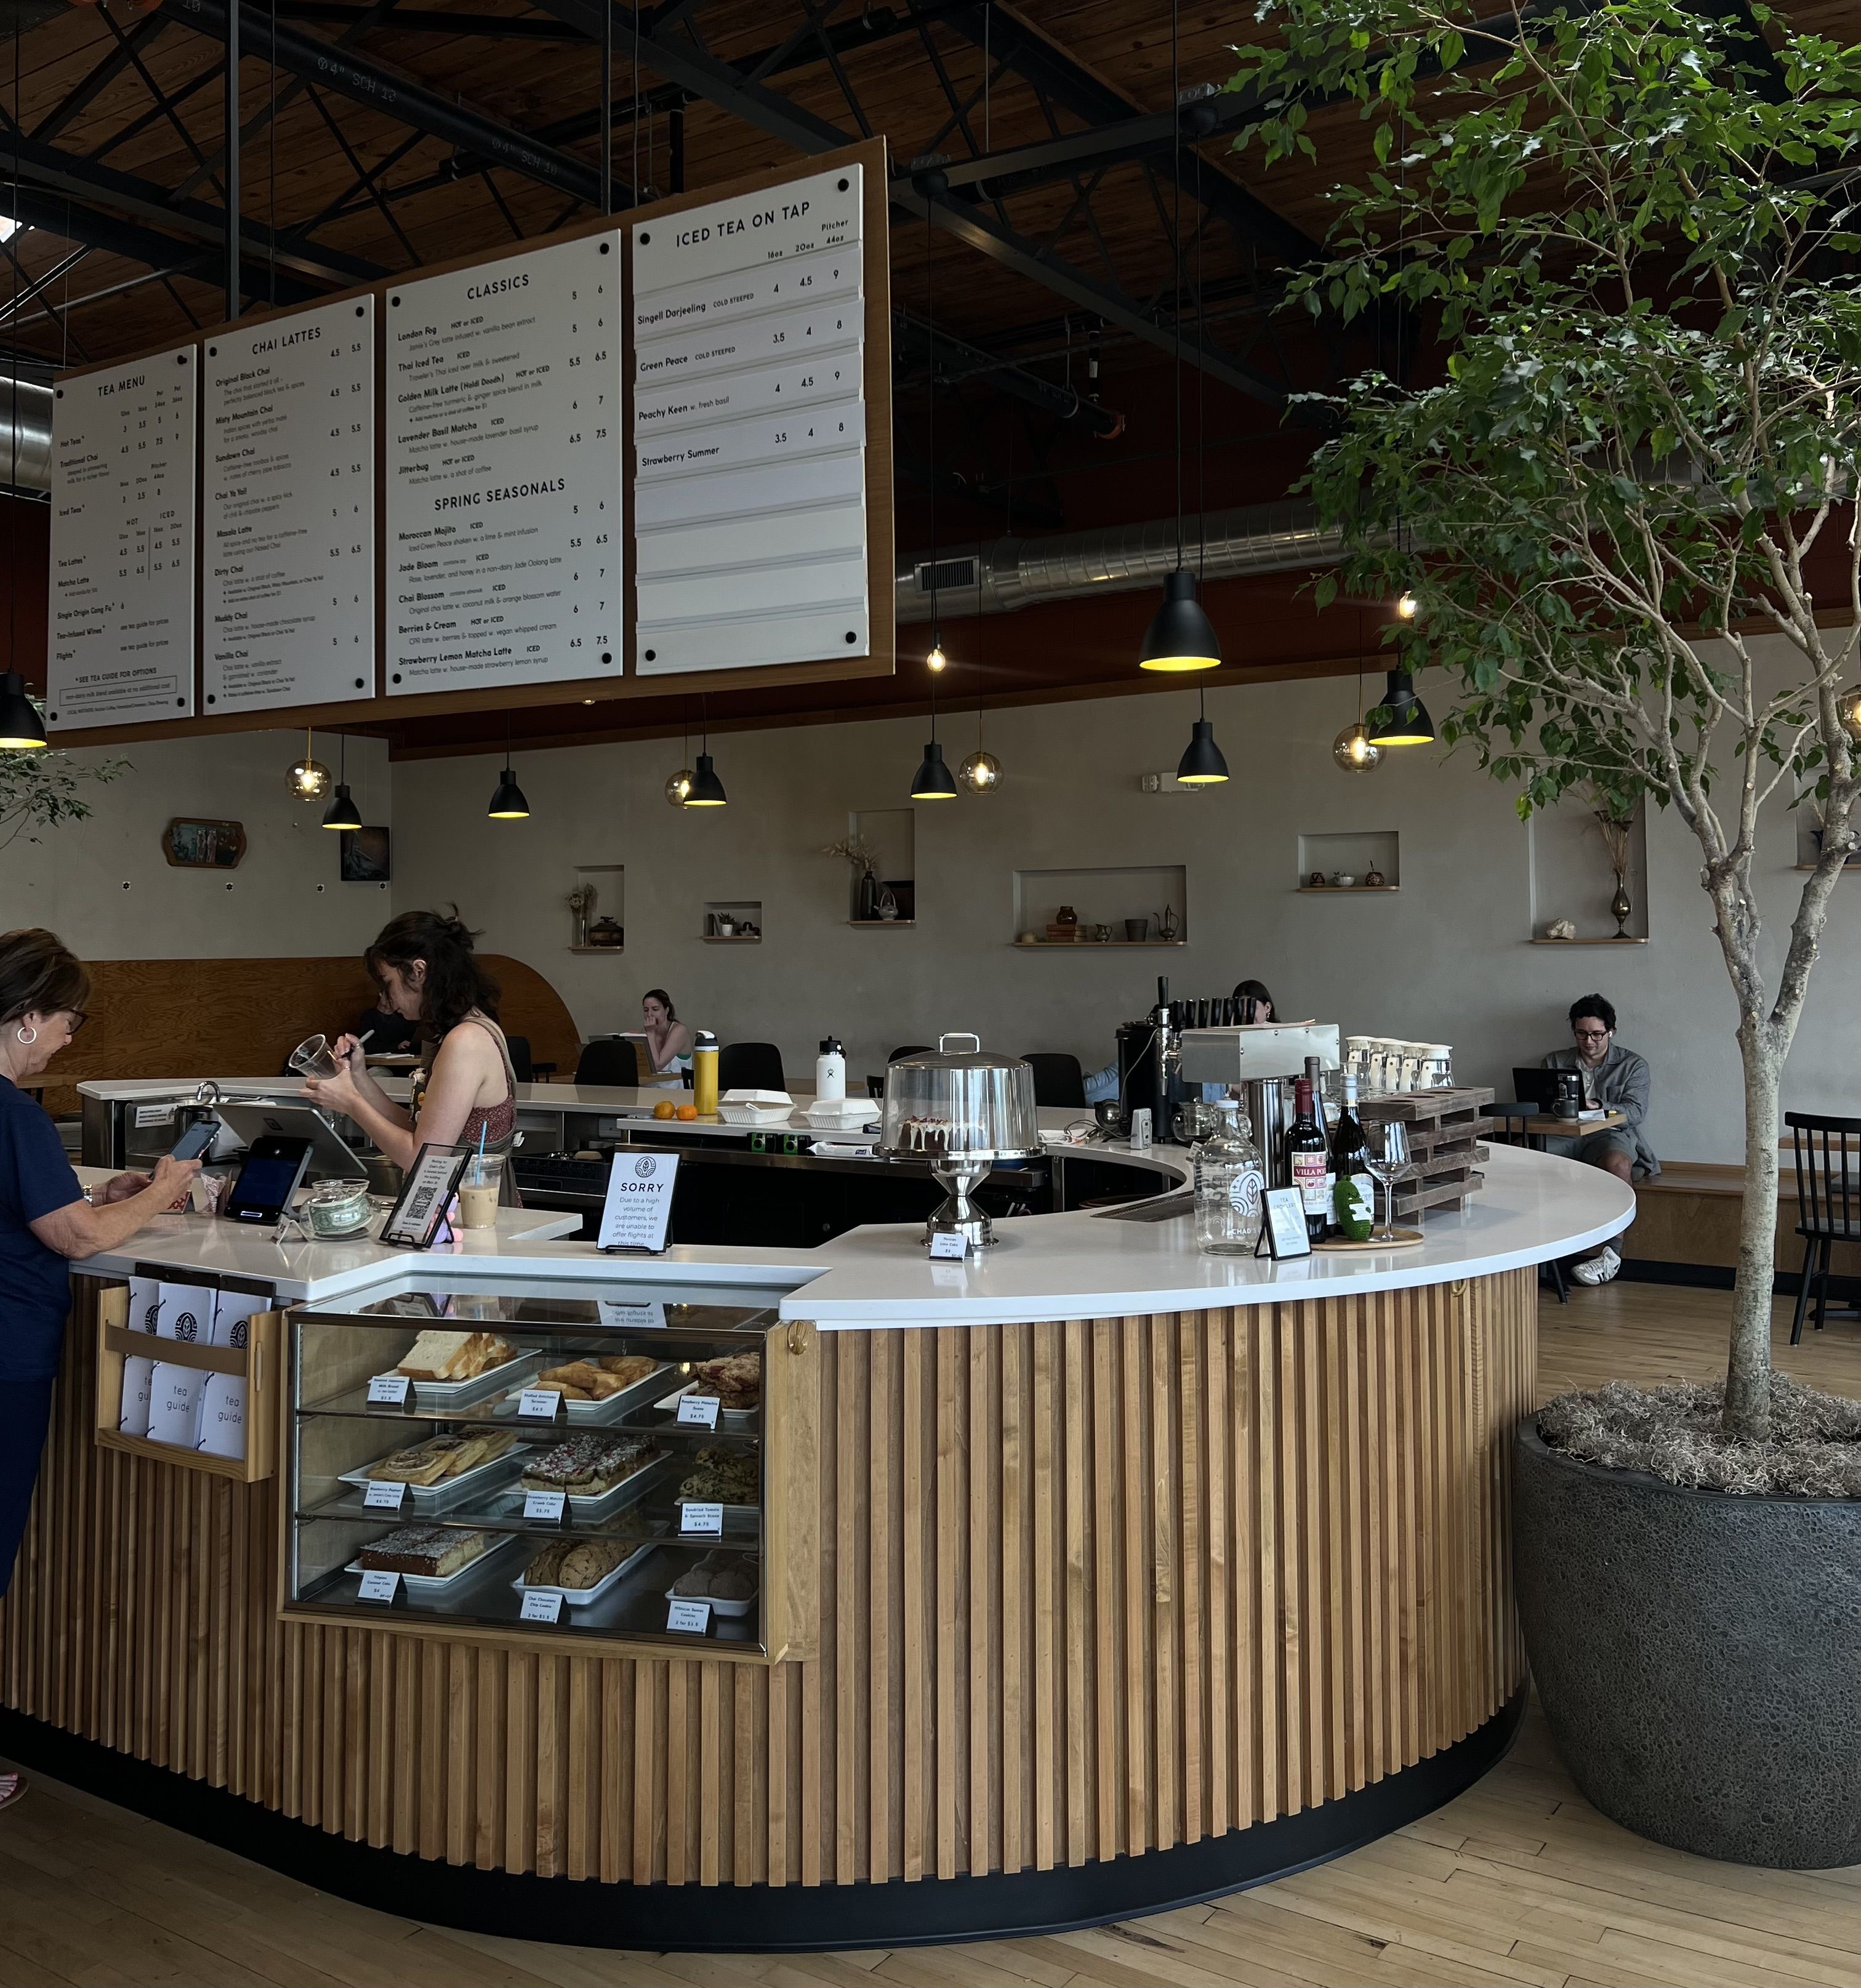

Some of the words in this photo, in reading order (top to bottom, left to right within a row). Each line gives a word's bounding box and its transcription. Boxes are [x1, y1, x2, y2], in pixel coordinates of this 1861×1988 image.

[352, 73, 376, 94] SCH
[677, 228, 710, 247] ICED
[717, 219, 745, 237] TEA
[752, 211, 774, 228] ON
[782, 201, 810, 220] TAP
[821, 220, 848, 232] Pitcher
[768, 251, 782, 259] 16oz
[795, 243, 814, 252] 20oz
[826, 235, 844, 244] 44oz
[467, 274, 529, 300] CLASSICS
[637, 310, 663, 325] Singell
[665, 304, 706, 318] Darjeeling
[713, 299, 728, 308] COLD
[730, 293, 754, 304] STEEPED
[774, 284, 779, 293] 4
[800, 276, 812, 286] 4.5
[833, 269, 839, 280] 9
[398, 329, 423, 341] London
[425, 326, 437, 336] Fog
[451, 321, 462, 329] HOT
[470, 316, 484, 324] ICED
[572, 291, 577, 300] 5
[598, 284, 603, 294] 6
[398, 361, 413, 372] Thai
[415, 358, 430, 368] Iced
[432, 356, 444, 364] Tea
[457, 351, 470, 360] ICED
[573, 324, 577, 333] 5
[598, 318, 603, 327] 6
[640, 361, 663, 372] Green
[665, 356, 688, 367] Peace
[694, 352, 710, 360] COLD
[711, 347, 736, 357] STEEPED
[773, 332, 785, 344] 3.5
[806, 326, 811, 336] 4
[837, 320, 842, 329] 8
[98, 384, 115, 397] TEA
[118, 375, 145, 392] MENU
[398, 392, 422, 403] Golden
[424, 388, 439, 398] Milk
[440, 385, 459, 394] Latte
[516, 369, 528, 378] HOT
[536, 364, 550, 374] ICED
[569, 356, 581, 367] 5.5
[595, 351, 606, 361] 6.5
[638, 409, 666, 421] Peachy
[668, 405, 688, 415] Keen
[699, 400, 713, 409] fresh
[715, 396, 730, 406] basil
[775, 384, 781, 393] 4
[801, 377, 814, 387] 4.5
[835, 371, 840, 380] 9
[398, 431, 430, 443] Lavender
[432, 426, 449, 437] Basil
[451, 422, 477, 433] Matcha
[491, 417, 504, 426] ICED
[573, 401, 577, 409] 6
[598, 395, 604, 404] 7
[398, 464, 429, 475] Jitterbug
[442, 458, 454, 466] HOT
[461, 454, 475, 463] ICED
[569, 433, 581, 443] 6.5
[596, 429, 606, 439] 7.5
[642, 453, 685, 467] Strawberry
[688, 447, 720, 459] Summer
[775, 432, 787, 443] 3.5
[808, 428, 814, 437] 4
[838, 422, 844, 432] 8
[435, 493, 480, 511] SPRING
[486, 478, 565, 502] SEASONALS
[126, 518, 139, 526] HOT
[159, 510, 175, 519] ICED
[399, 531, 432, 541] Moroccan
[434, 526, 456, 536] Mojito
[470, 521, 483, 529] ICED
[573, 505, 578, 514] 5
[599, 501, 605, 510] 6
[398, 563, 415, 572] Jade
[417, 561, 438, 569] Bloom
[476, 553, 489, 561] ICED
[570, 538, 582, 548] 5.5
[596, 534, 608, 544] 6.5
[398, 595, 414, 603] Chai
[417, 592, 444, 601] Blossom
[492, 584, 506, 592] ICED
[573, 572, 579, 581] 6
[600, 568, 605, 577] 7
[398, 626, 424, 634] Berries
[425, 622, 432, 631] &
[433, 621, 457, 630] Cream
[573, 605, 579, 613] 6
[600, 602, 605, 610] 7
[398, 656, 438, 666] Strawberry
[440, 653, 463, 661] Lemon
[465, 649, 492, 659] Matcha
[494, 648, 512, 656] Latte
[526, 645, 541, 653] ICED
[570, 638, 582, 648] 6.5
[597, 635, 608, 645] 7.5
[621, 1183, 664, 1193] SORRY
[145, 1376, 153, 1386] te
[173, 1385, 187, 1396] tea
[166, 1401, 190, 1412] guide
[225, 1395, 239, 1407] tea
[217, 1411, 242, 1424] guide
